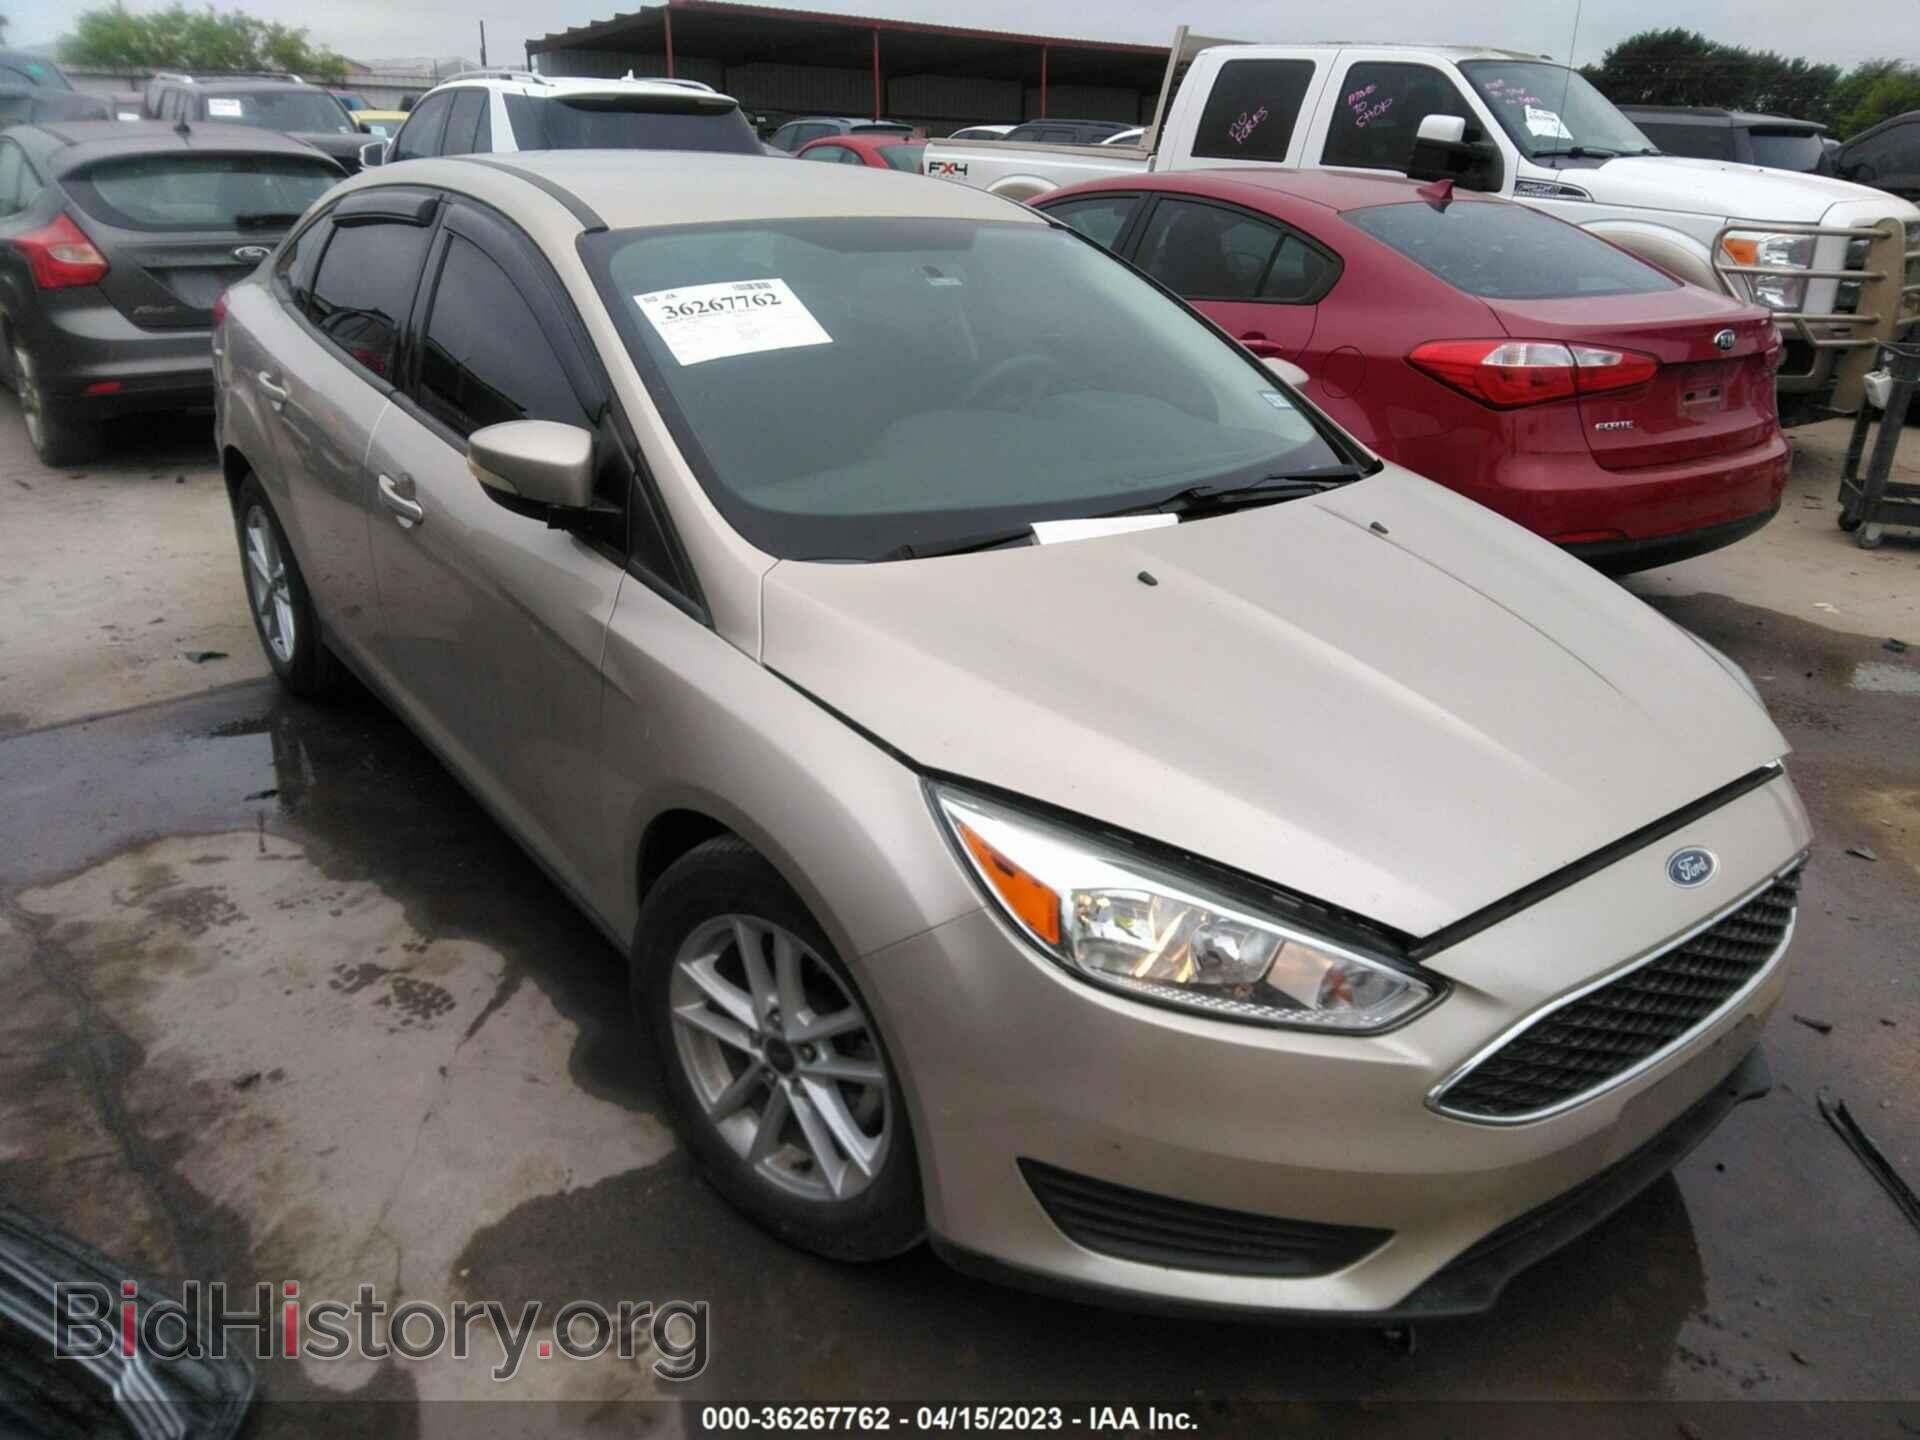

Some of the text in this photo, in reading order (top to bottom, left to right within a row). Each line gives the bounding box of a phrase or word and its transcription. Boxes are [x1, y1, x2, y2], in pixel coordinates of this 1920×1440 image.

[928, 161, 968, 176] FX4
[661, 292, 782, 320] 36267762
[1678, 855, 1708, 881] Ford
